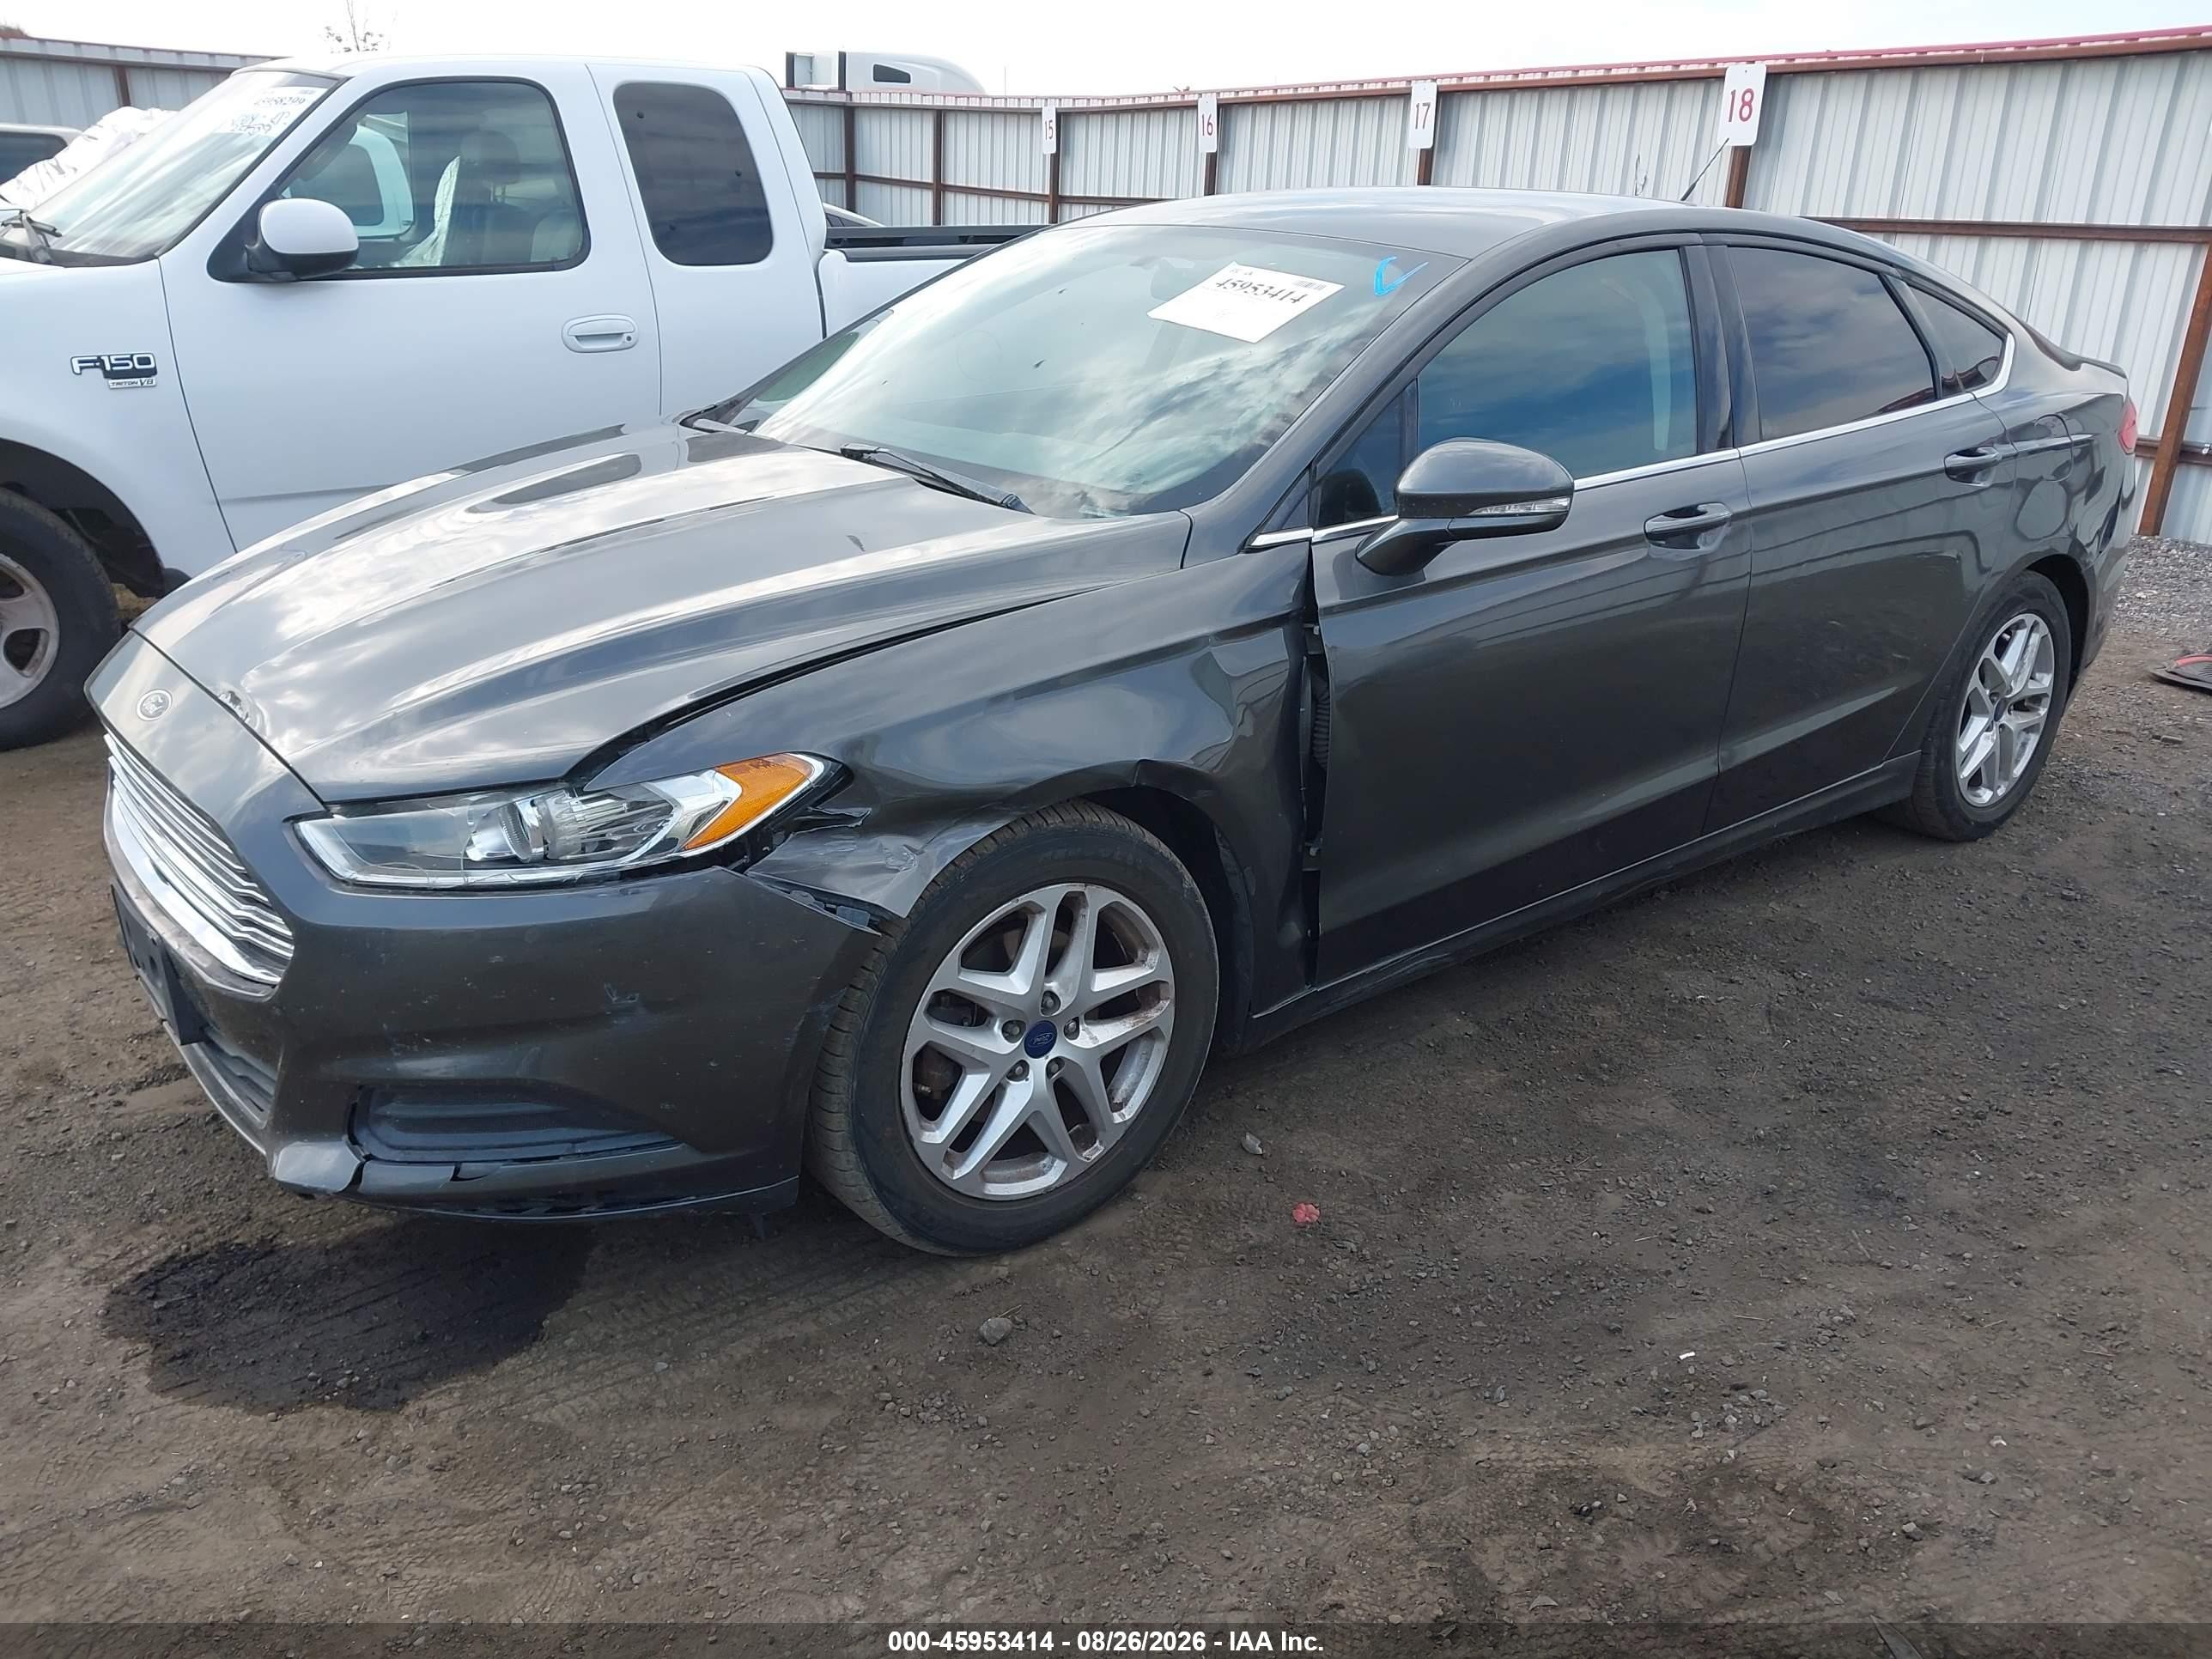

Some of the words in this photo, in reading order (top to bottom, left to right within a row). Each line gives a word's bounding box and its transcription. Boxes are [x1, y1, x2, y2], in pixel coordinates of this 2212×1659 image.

[1415, 102, 1431, 130] 17
[1729, 88, 1754, 122] 18
[1044, 119, 1054, 140] 15
[1201, 113, 1213, 136] 16
[1216, 278, 1308, 304] 45953414
[140, 378, 154, 386] V8
